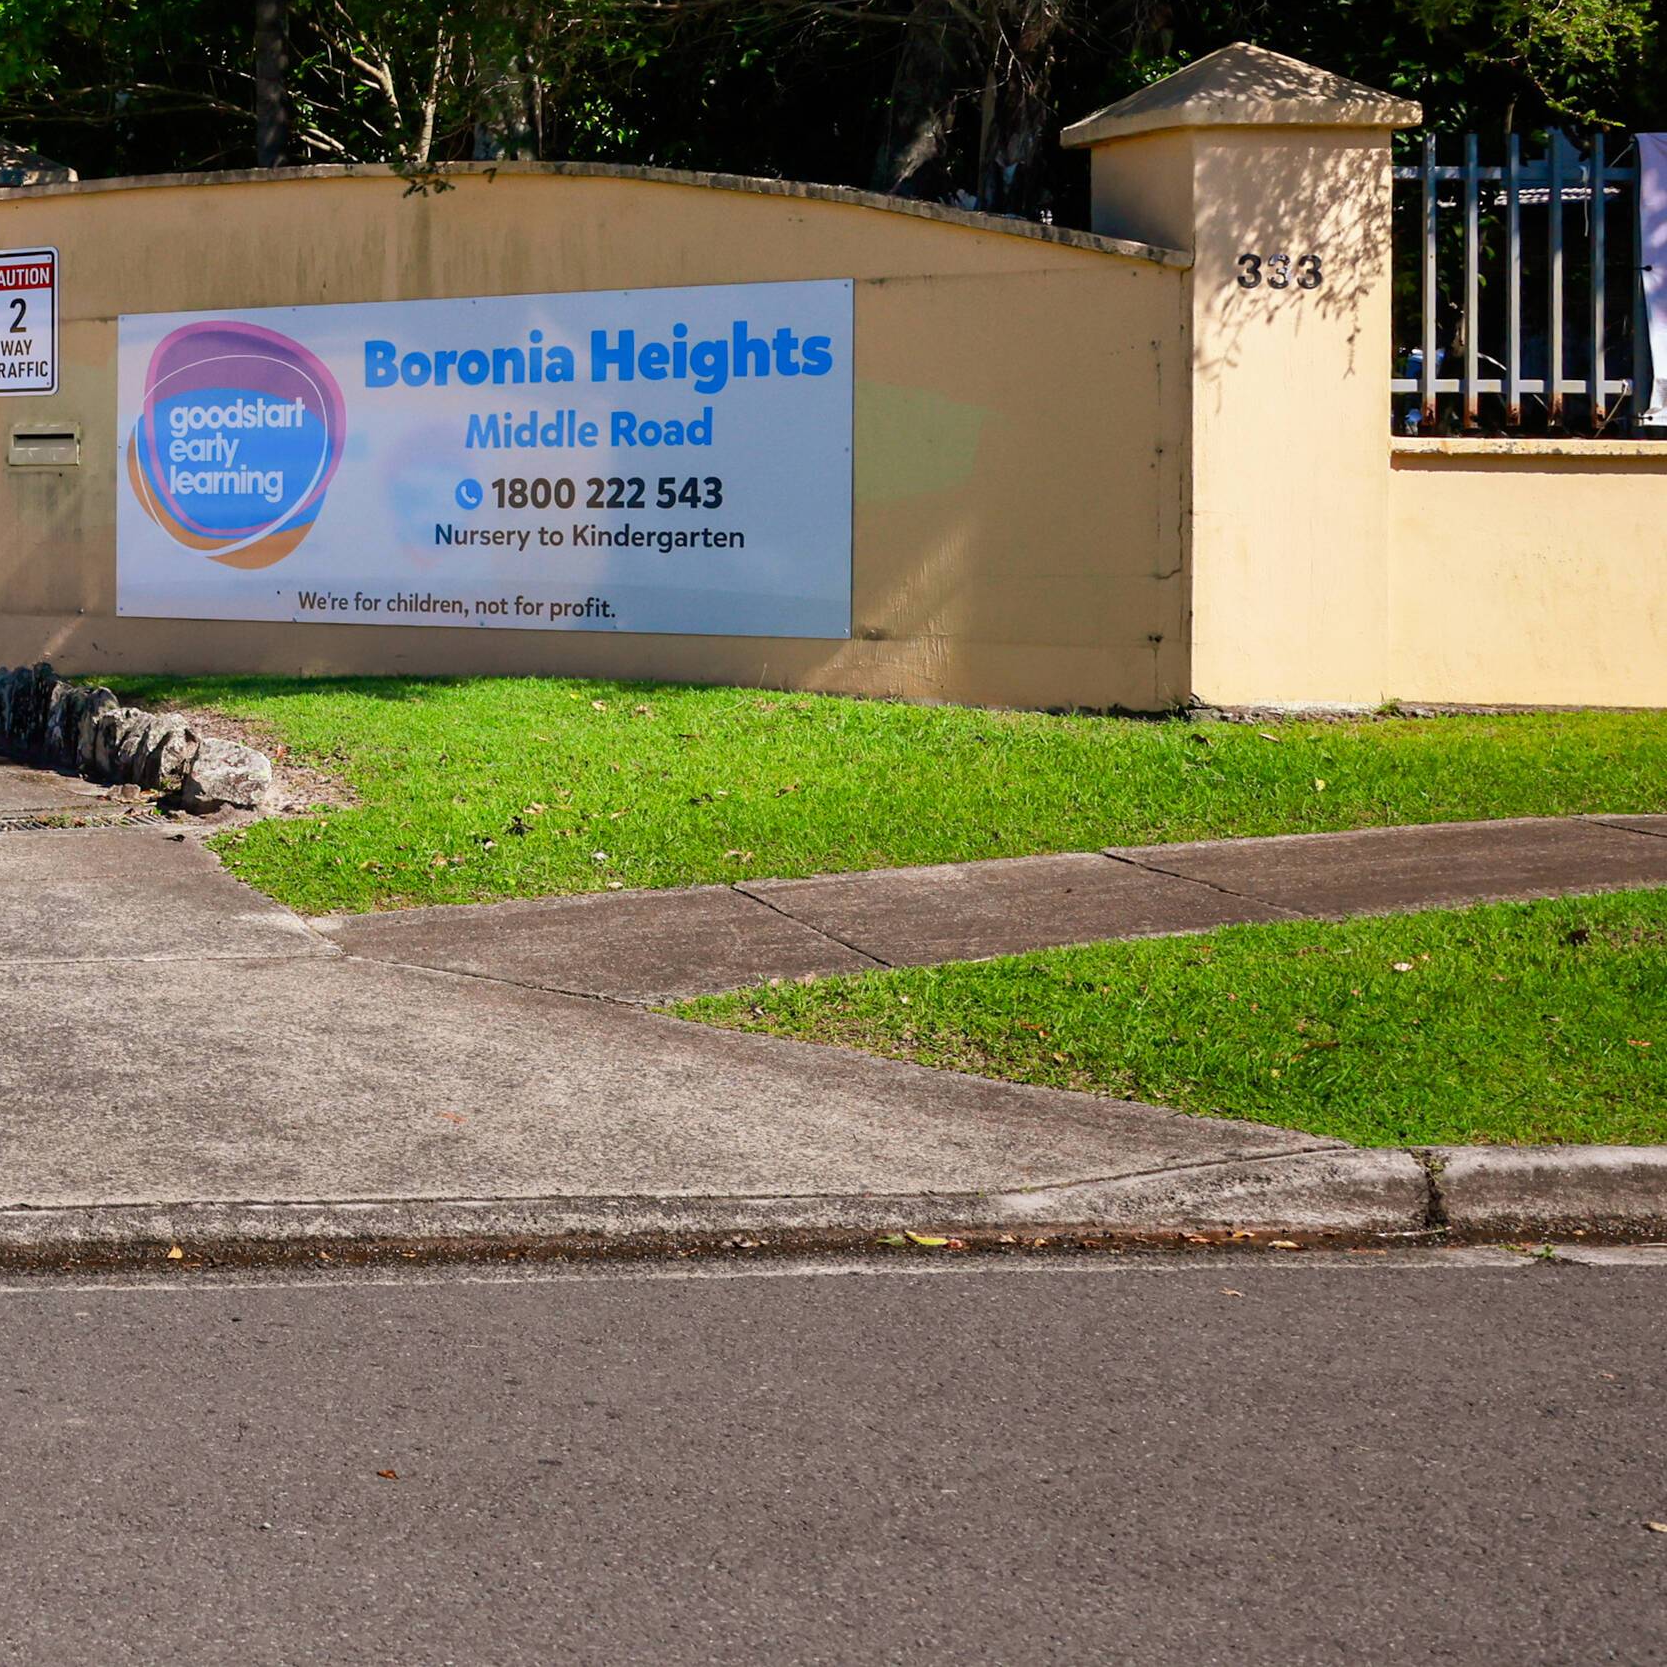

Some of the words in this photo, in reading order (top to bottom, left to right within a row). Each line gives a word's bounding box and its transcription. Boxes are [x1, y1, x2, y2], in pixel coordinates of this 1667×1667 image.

[1236, 253, 1323, 289] 333
[10, 298, 26, 333] 2
[1, 339, 32, 356] WAY
[365, 330, 574, 387] Boronia
[591, 321, 833, 394] Heights
[170, 397, 305, 438] goodstart
[465, 409, 599, 448] Middle
[611, 406, 713, 446] Road
[169, 432, 240, 468] early
[170, 465, 283, 503] learning
[492, 478, 575, 509] 1800
[587, 477, 645, 508] 222
[656, 477, 722, 509] 543
[435, 524, 530, 551] Nursery
[538, 527, 563, 546] to
[573, 523, 744, 553] Kindergarten
[298, 591, 348, 610] We're
[354, 592, 381, 611] for
[387, 592, 469, 617] children,
[476, 598, 508, 615] not
[514, 595, 544, 615] for
[551, 597, 615, 621] profit.
